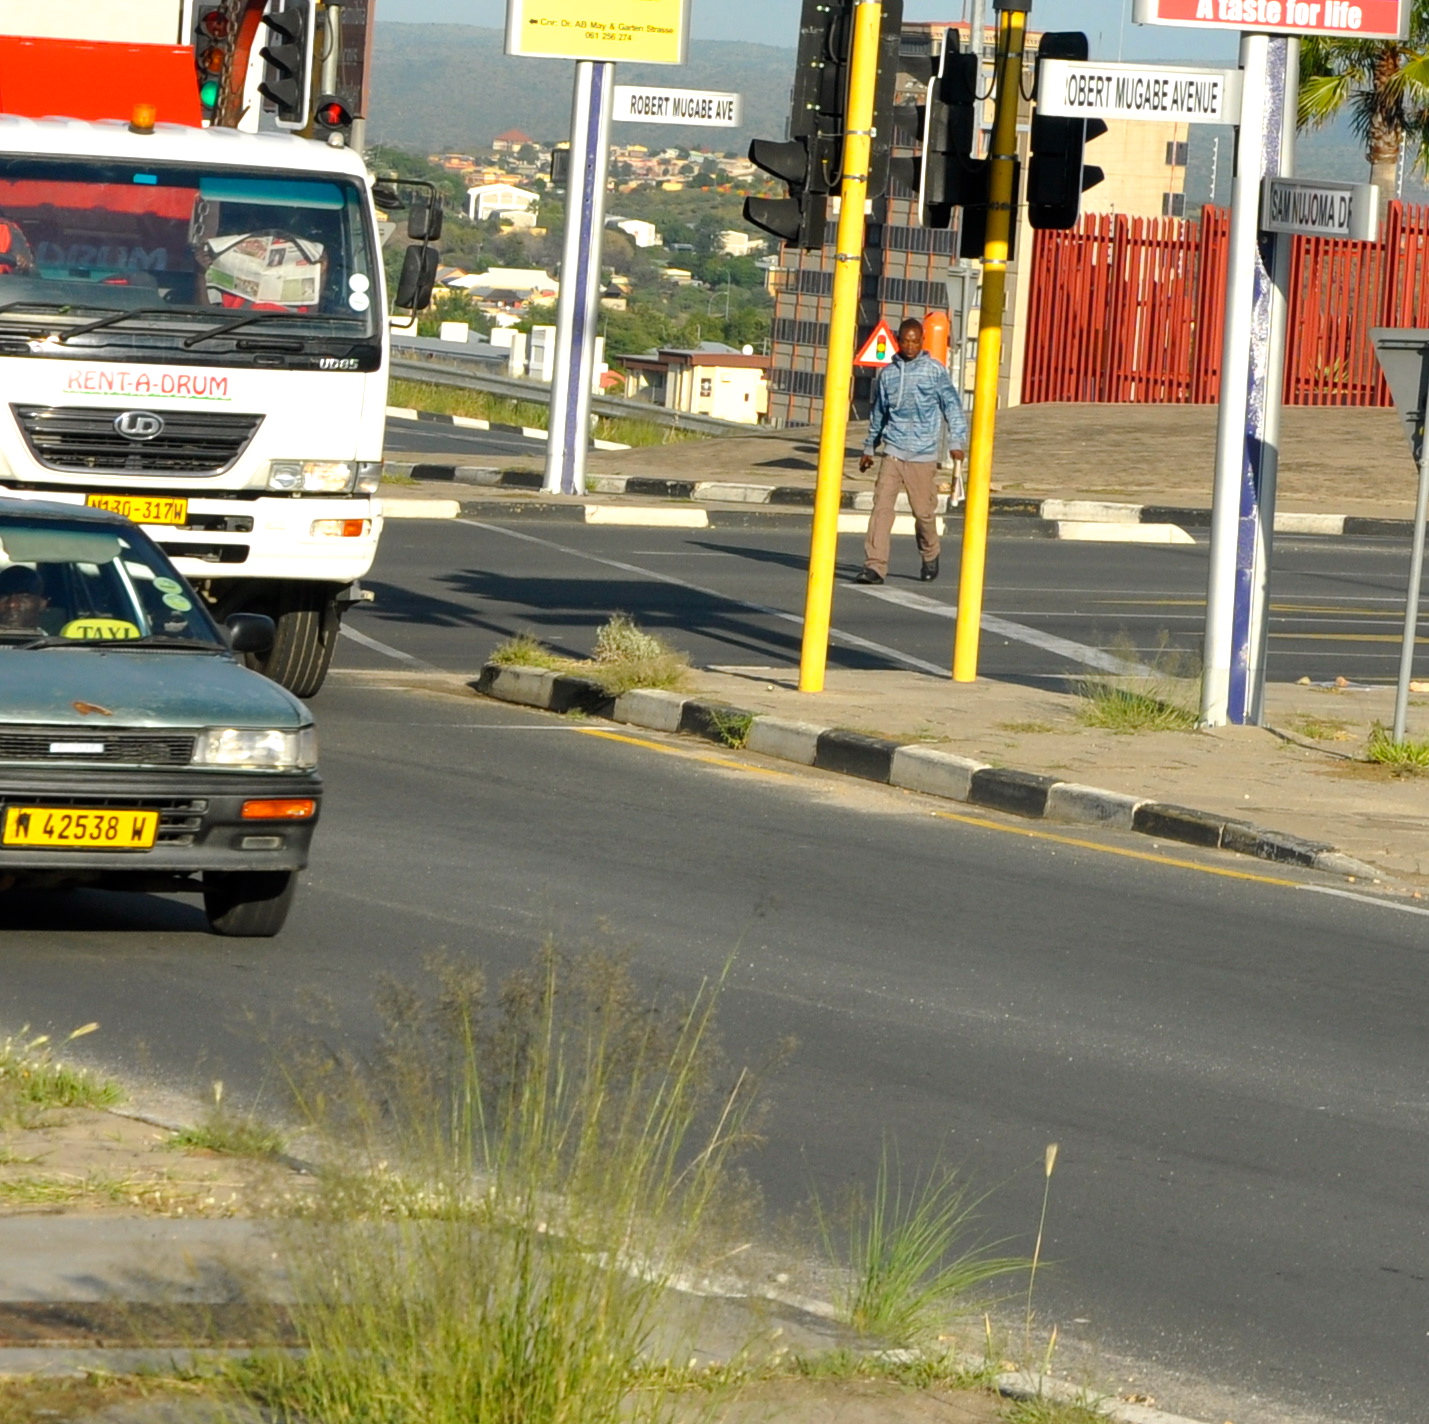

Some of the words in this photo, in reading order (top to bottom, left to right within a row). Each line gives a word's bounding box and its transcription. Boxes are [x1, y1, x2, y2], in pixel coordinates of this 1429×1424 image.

[618, 23, 643, 32] Garten
[647, 25, 674, 34] Strasse
[1324, 0, 1362, 29] life
[630, 94, 669, 117] ROBERT
[672, 97, 713, 120] MUGABE
[715, 100, 733, 121] AVE
[1064, 74, 1112, 108] OBERT
[1115, 77, 1169, 111] MUGABE
[1170, 80, 1218, 114] AVENUE
[1272, 189, 1291, 223] SAM
[1291, 191, 1335, 227] NUJOMA
[67, 369, 228, 396] RENT-A-DRUM
[77, 626, 133, 639] TAXI
[42, 813, 119, 841] 42538
[130, 817, 147, 842] W
